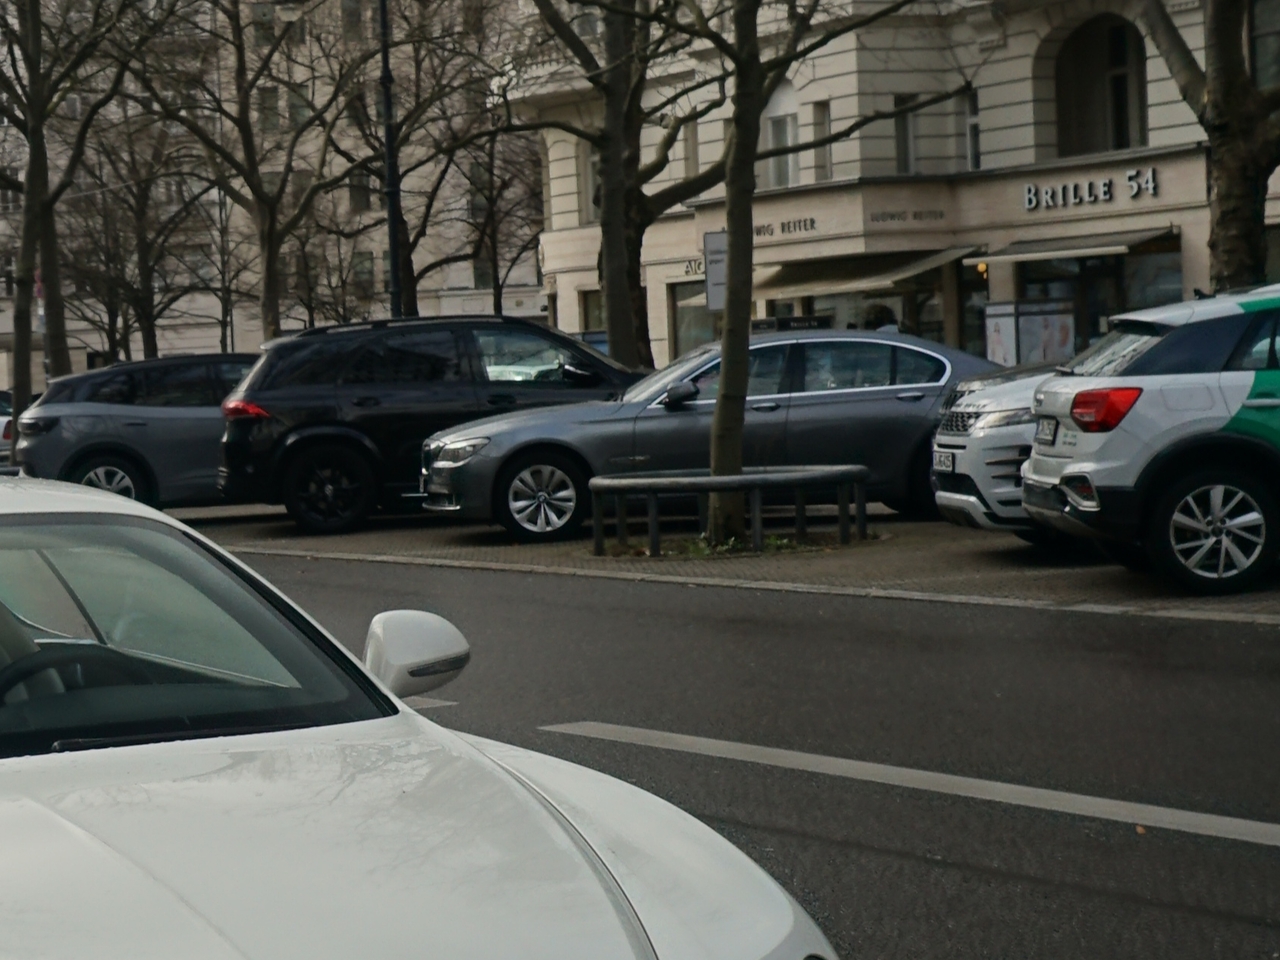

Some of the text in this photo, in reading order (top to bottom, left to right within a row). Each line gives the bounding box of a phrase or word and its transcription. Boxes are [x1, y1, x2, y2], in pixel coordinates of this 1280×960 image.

[1024, 167, 1157, 211] BRILLE 54
[781, 217, 817, 234] REITER
